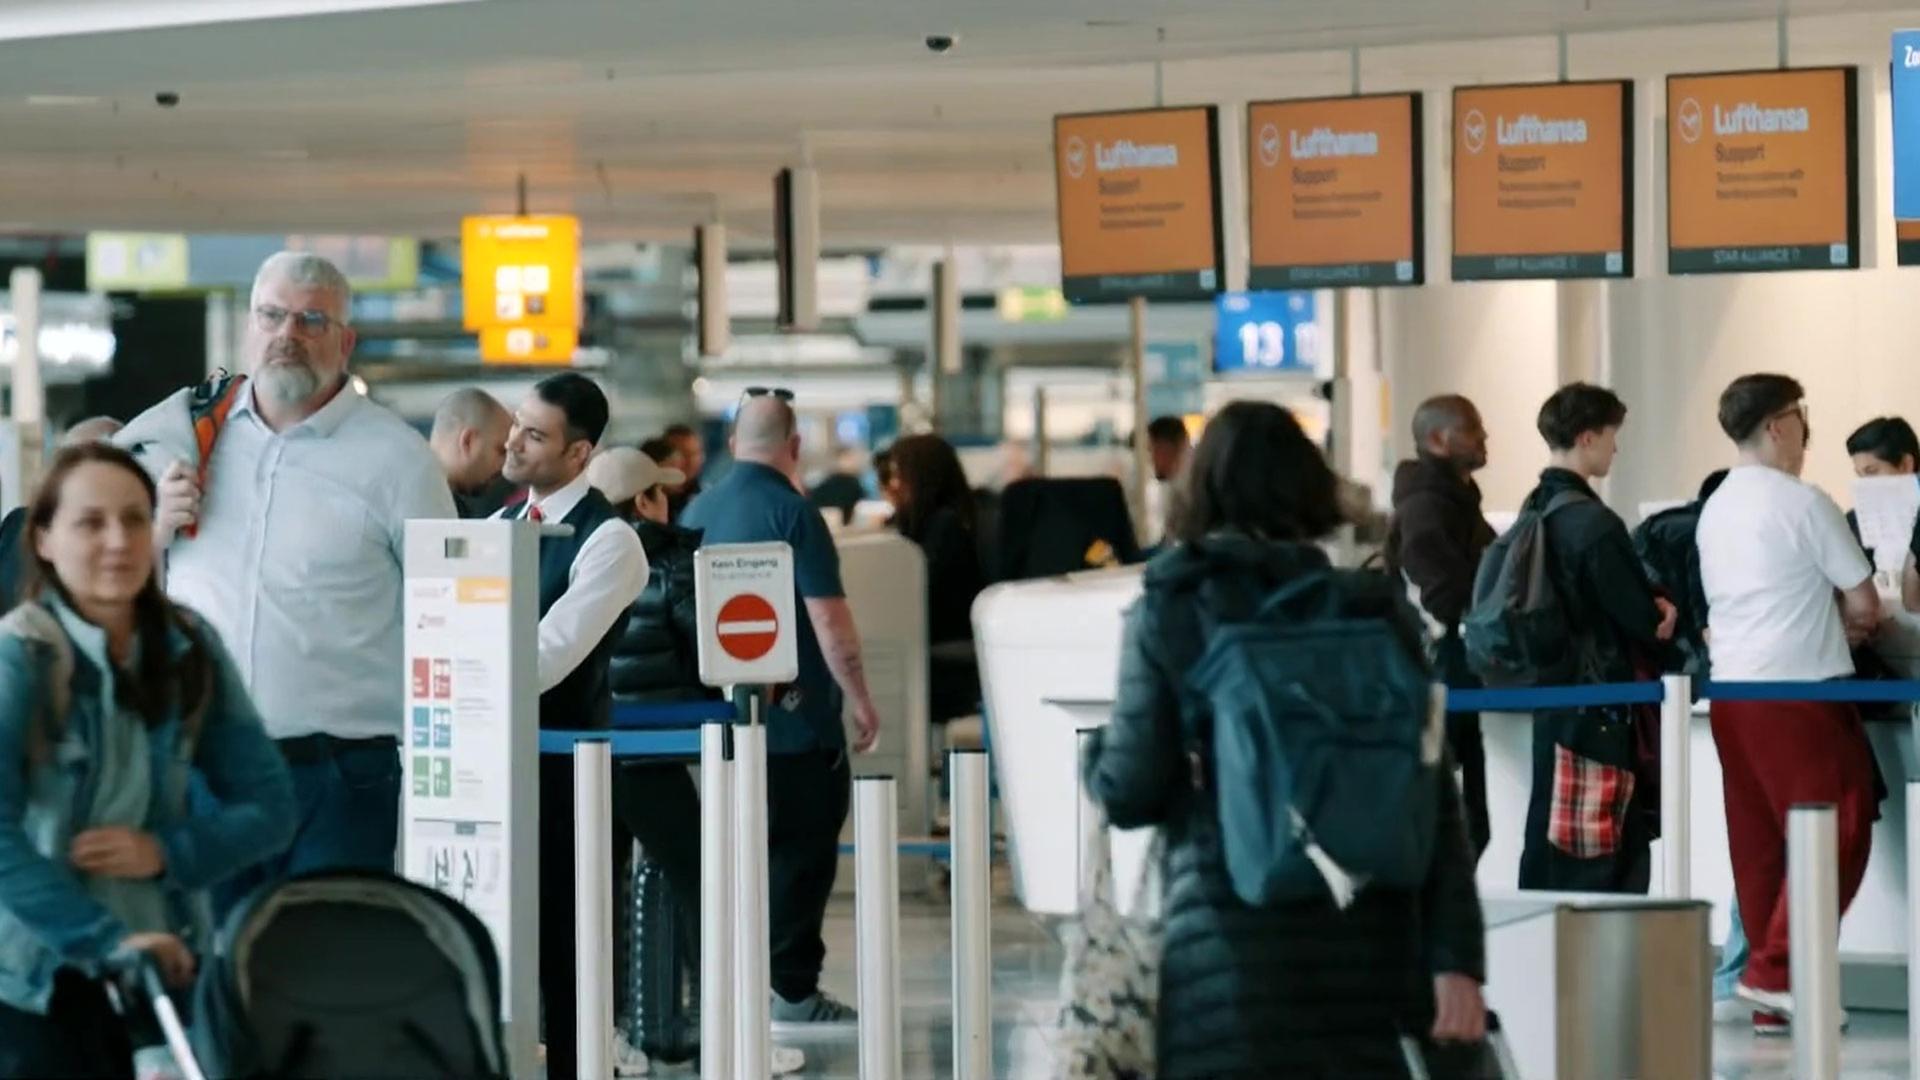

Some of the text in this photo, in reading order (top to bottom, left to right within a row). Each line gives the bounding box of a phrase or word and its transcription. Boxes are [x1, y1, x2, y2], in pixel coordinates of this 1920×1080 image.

[1904, 44, 1920, 68] Zo
[1496, 114, 1587, 145] Lufthansa
[1714, 102, 1808, 134] Lufthansa
[1094, 139, 1178, 170] Lufthansa
[1289, 128, 1379, 158] Lufthansa
[1715, 142, 1765, 163] Support
[1239, 321, 1284, 367] 13
[711, 557, 779, 569] Kein Eingang
